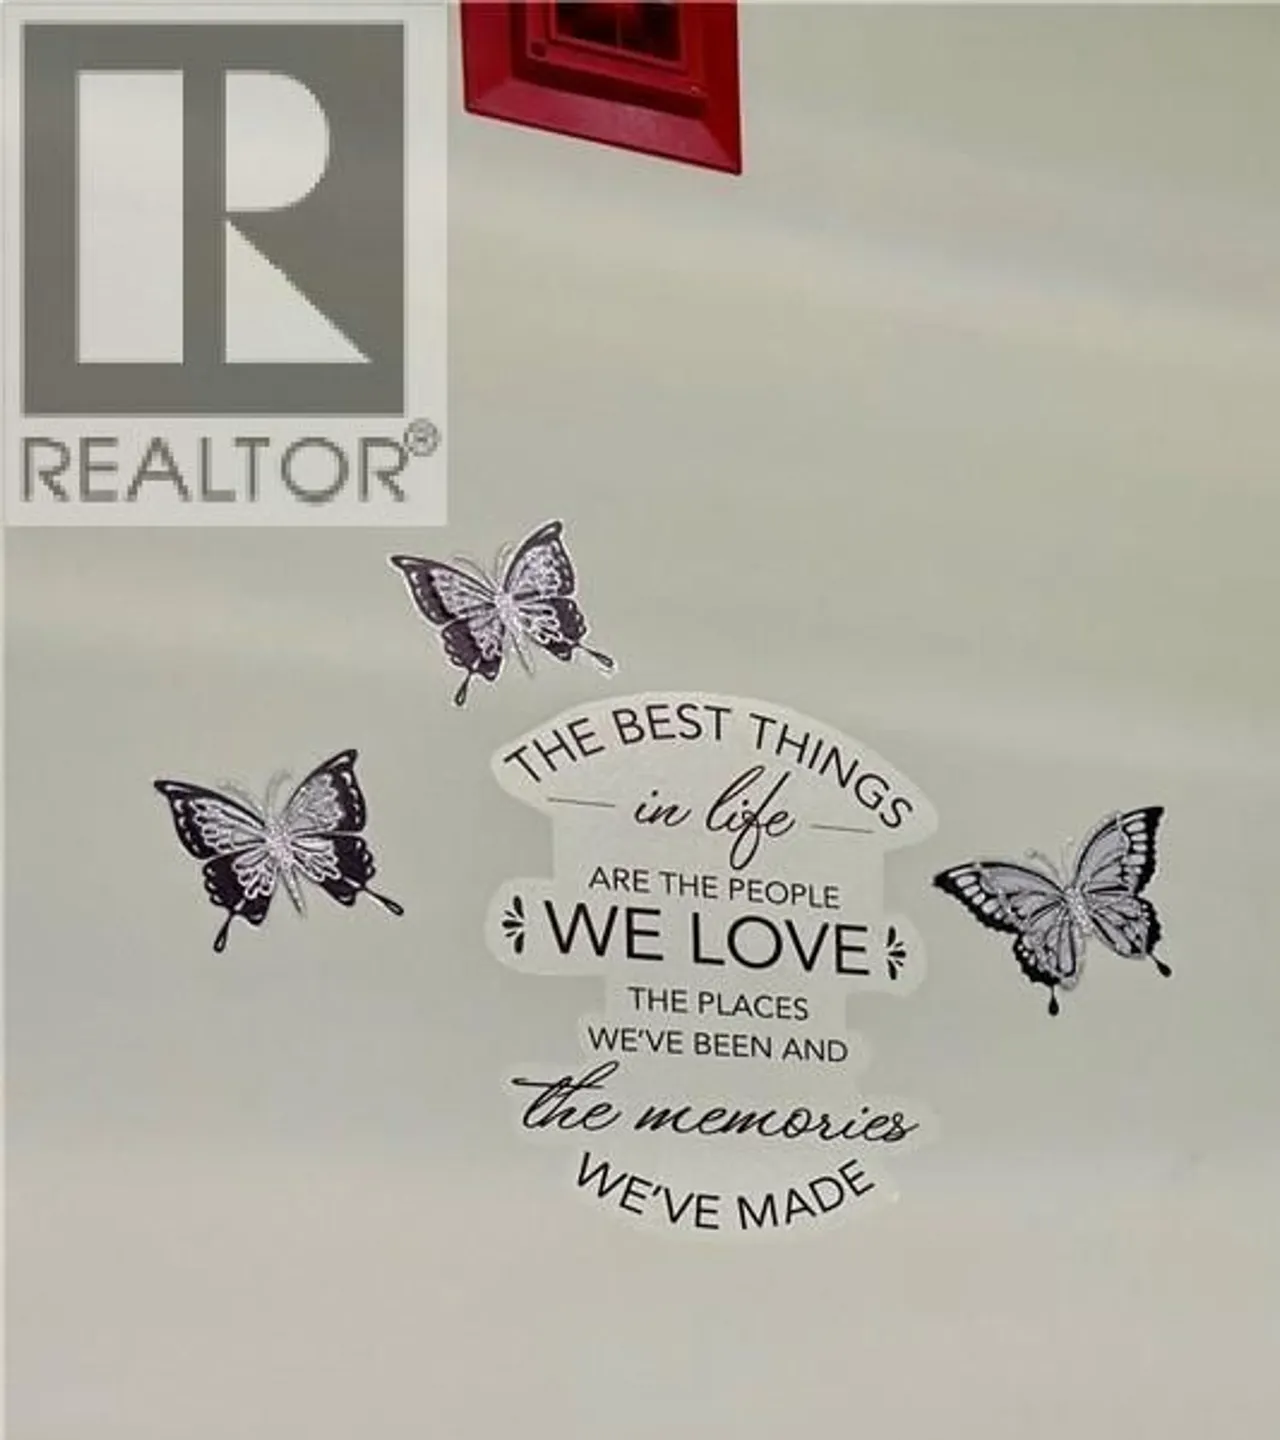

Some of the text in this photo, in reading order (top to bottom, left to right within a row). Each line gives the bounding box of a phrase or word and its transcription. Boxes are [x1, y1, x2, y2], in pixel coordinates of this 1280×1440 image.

[503, 703, 914, 830] THE BEST THINGS
[634, 765, 796, 870] in life
[588, 867, 841, 910] ARE THE PEOPLE
[544, 901, 871, 976] WE LOVE
[627, 987, 809, 1021] THE PLACES
[588, 1026, 848, 1063] WE'VE BEEN AND
[512, 1060, 920, 1144] the memories
[576, 1151, 875, 1231] WE'VE MADE
